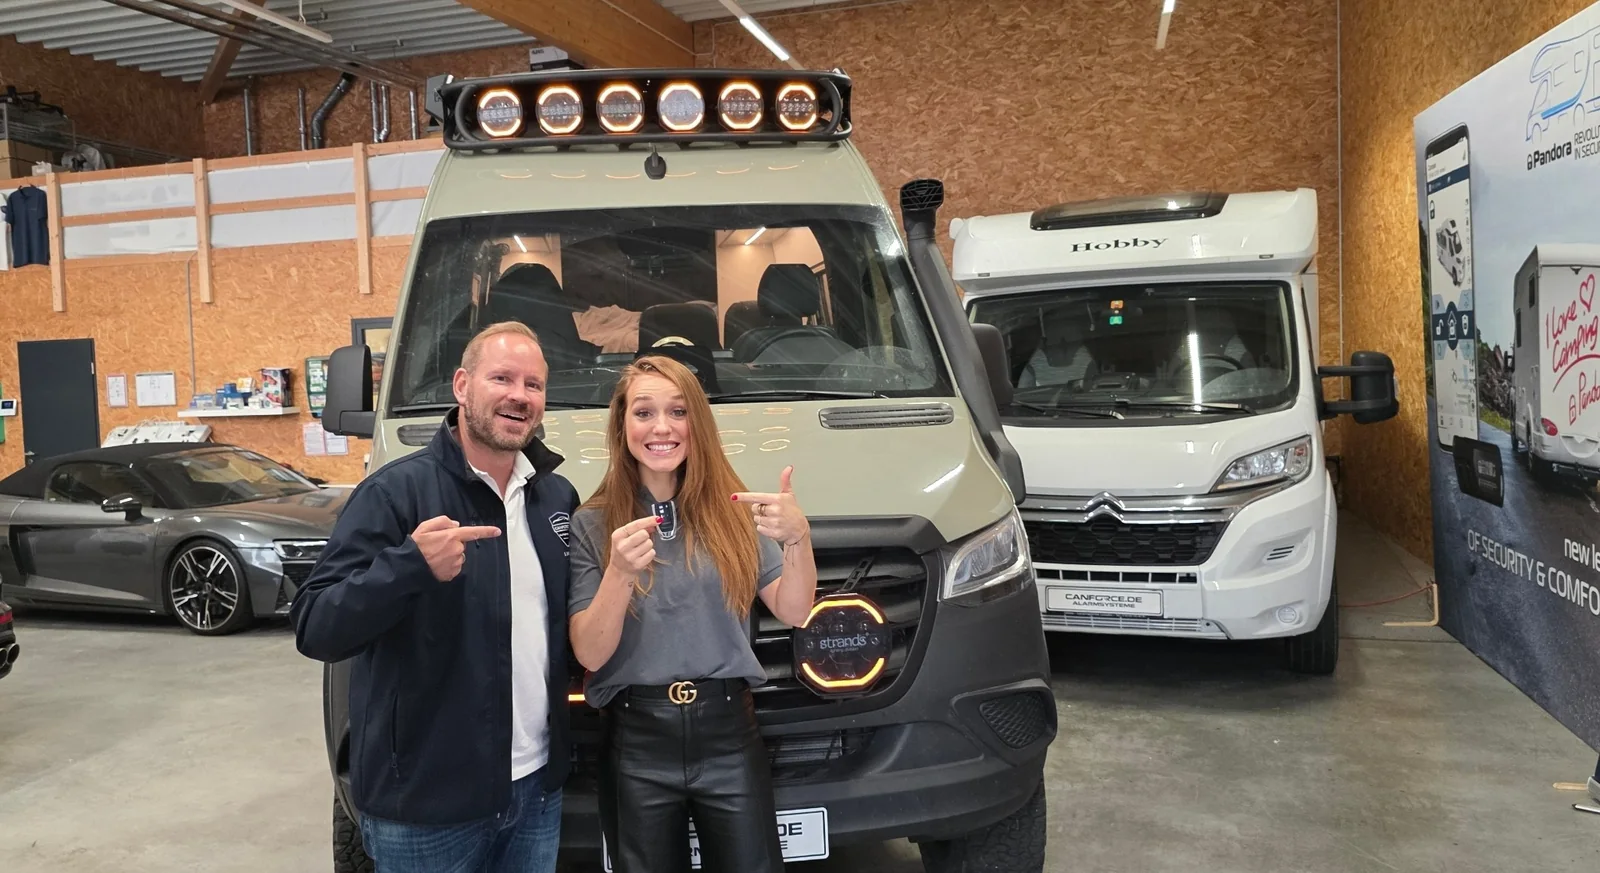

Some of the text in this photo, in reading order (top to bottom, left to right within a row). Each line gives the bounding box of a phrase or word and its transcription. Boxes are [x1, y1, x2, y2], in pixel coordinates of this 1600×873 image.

[1574, 124, 1600, 146] REVOLU
[1533, 141, 1572, 169] Pandora
[1575, 147, 1581, 160] IN
[1070, 237, 1168, 253] Hobby
[1552, 315, 1598, 373] Camping
[1467, 529, 1480, 552] OF
[1481, 536, 1534, 581] SECURITY
[1536, 561, 1546, 587] &
[1564, 538, 1590, 566] new
[1065, 593, 1143, 603] CANFORCE.DE
[1072, 600, 1136, 609] ALARMSYSTEME
[820, 633, 867, 649] strands
[777, 822, 802, 837] DE
